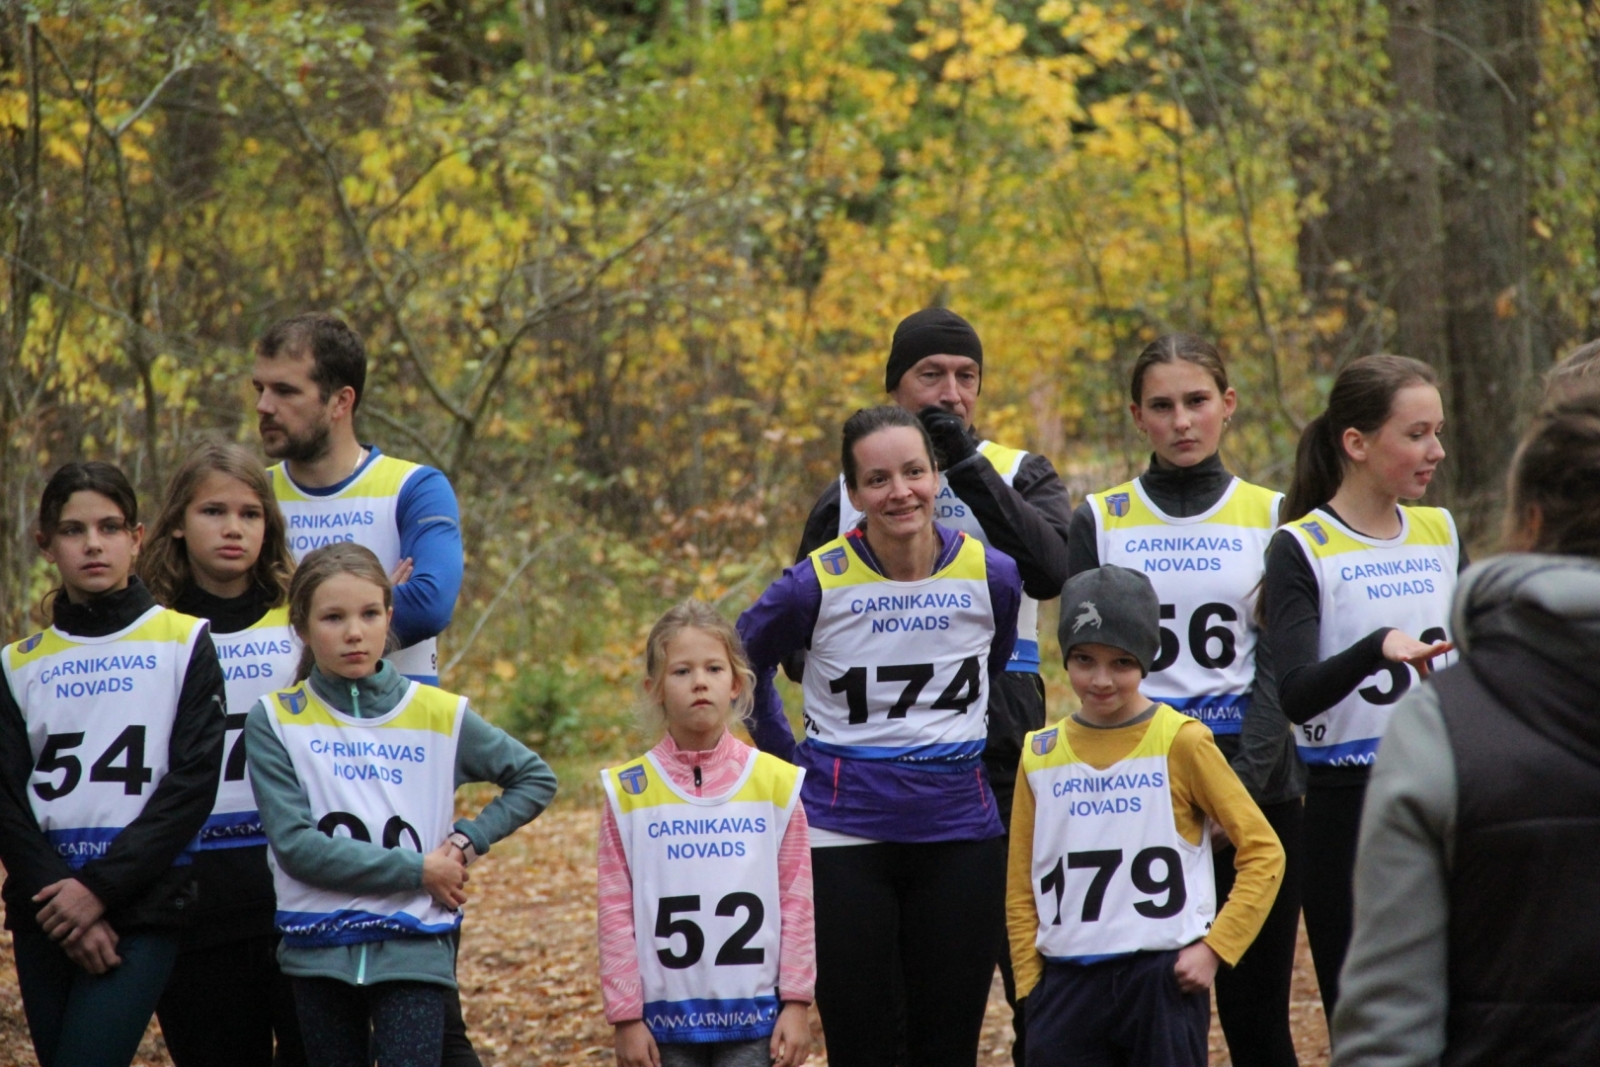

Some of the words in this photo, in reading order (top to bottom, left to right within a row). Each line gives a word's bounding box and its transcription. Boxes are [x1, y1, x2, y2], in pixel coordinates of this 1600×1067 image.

[1125, 536, 1243, 553] CARNIKAVAS
[1144, 557, 1222, 572] NOVADS
[1340, 557, 1442, 581] CARNIKAVAS
[1366, 578, 1435, 600] NOVADS
[851, 593, 972, 614] CARNIKAVAS
[872, 615, 950, 633] NOVADS
[1150, 602, 1238, 672] 56
[40, 655, 157, 684] CARNIKAVAS
[56, 677, 133, 699] NOVADS
[829, 656, 981, 725] 174
[1303, 724, 1326, 742] 50
[309, 739, 426, 764] CARNIKAVAS
[33, 724, 153, 802] 54
[1052, 772, 1164, 798] CARNIKAVAS
[1069, 796, 1143, 816] NOVADS
[647, 818, 767, 838] CARNIKAVAS
[667, 841, 747, 860] NOVADS
[1040, 846, 1187, 926] 179
[654, 891, 765, 970] 52
